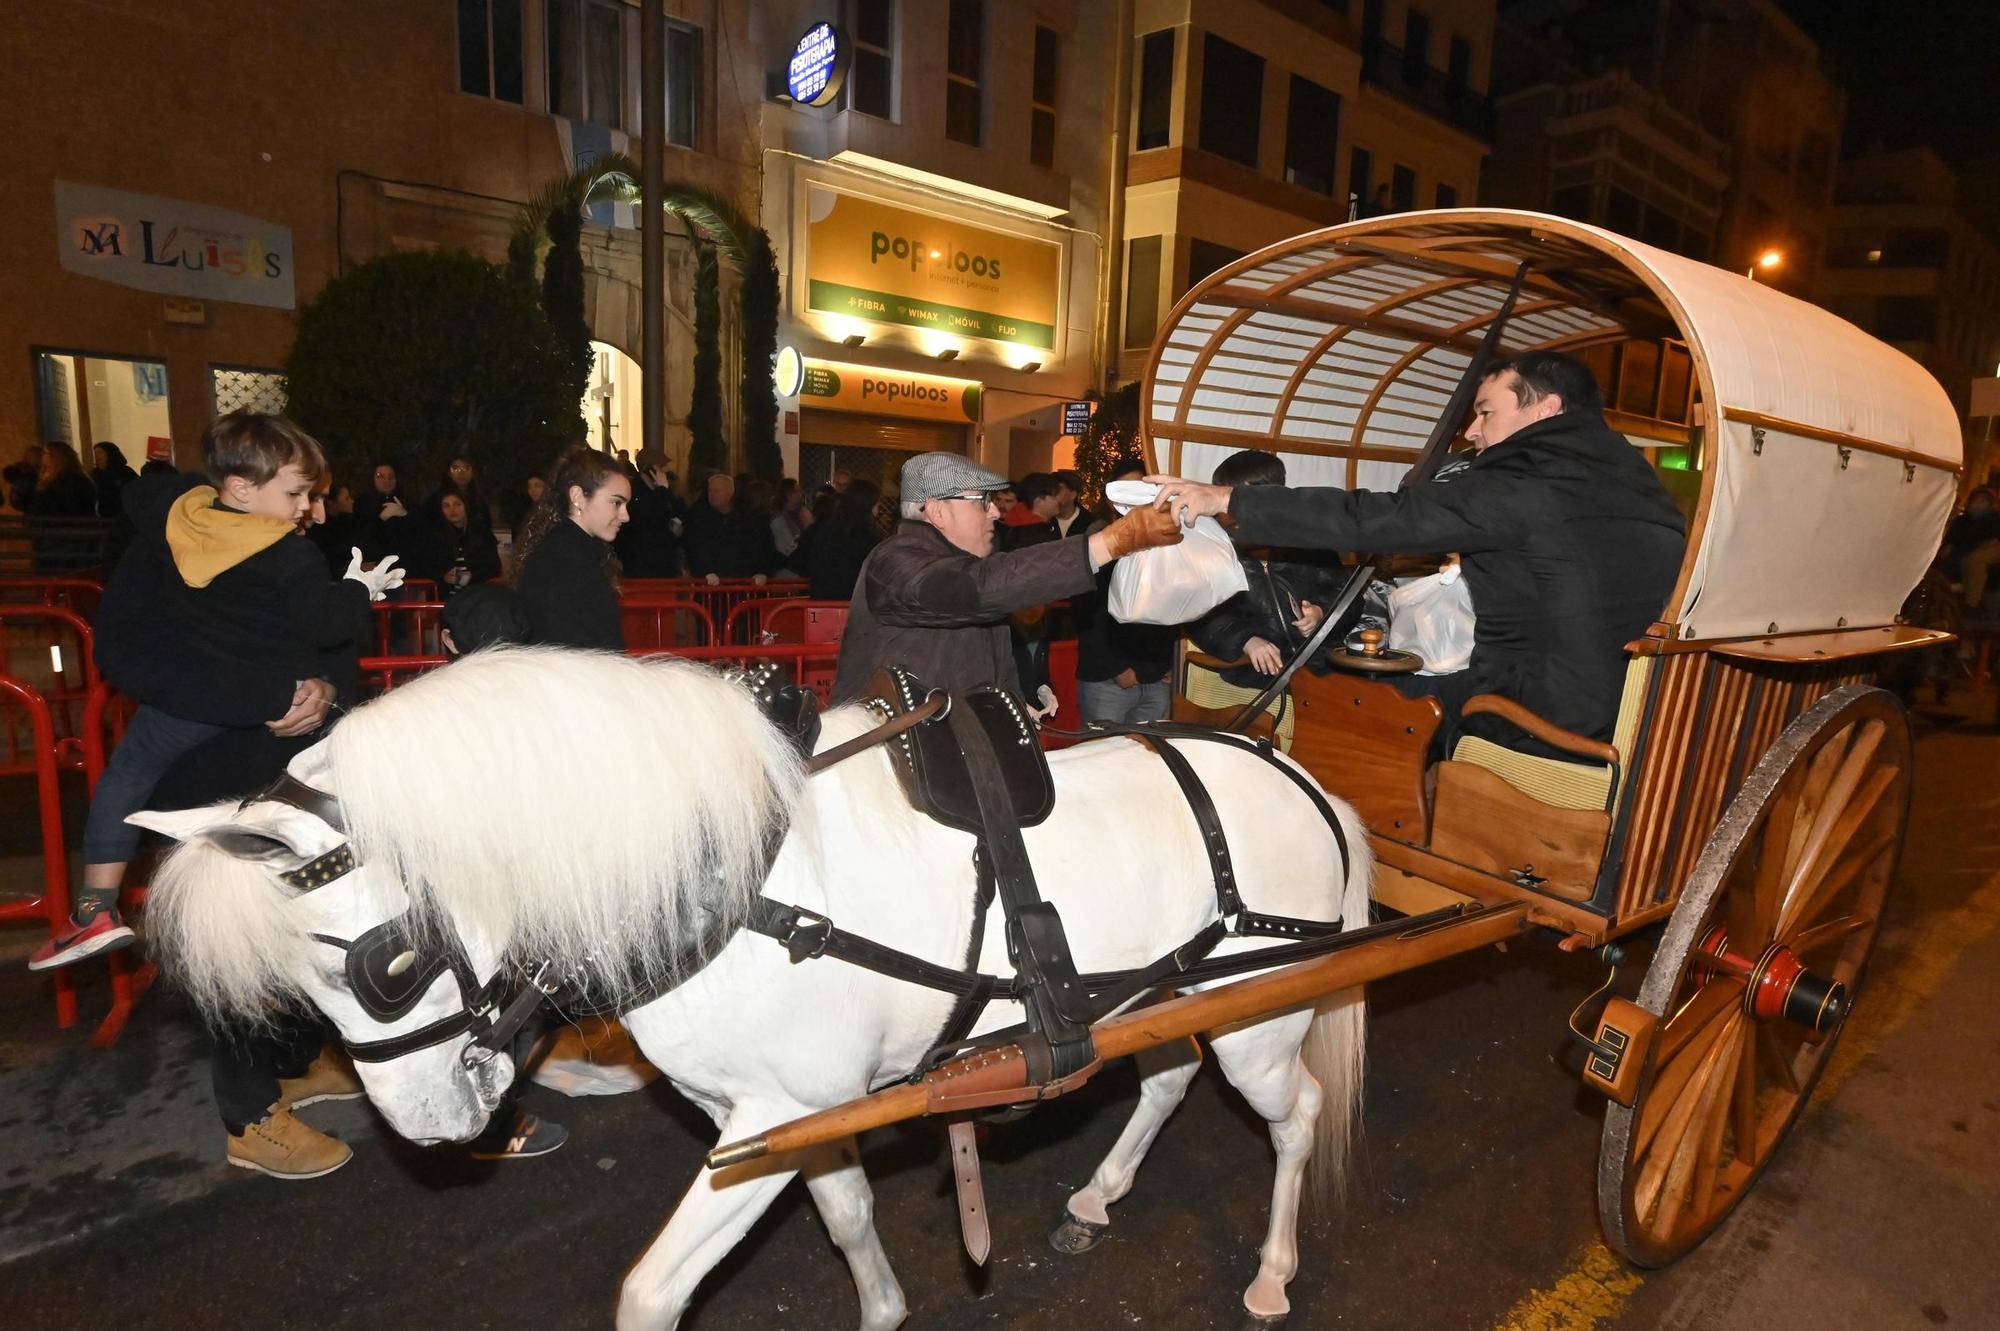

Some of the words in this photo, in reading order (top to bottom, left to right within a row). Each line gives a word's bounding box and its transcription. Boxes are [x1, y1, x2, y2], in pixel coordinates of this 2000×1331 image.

[791, 34, 836, 75] FISIOTERAPIA
[871, 231, 1000, 280] poploos
[857, 298, 886, 313] FIBRA
[908, 308, 939, 322] WIMAX
[954, 315, 981, 330] MÓVIL
[998, 325, 1017, 336] FIJO
[862, 378, 948, 402] populoos
[505, 1136, 527, 1152] N
